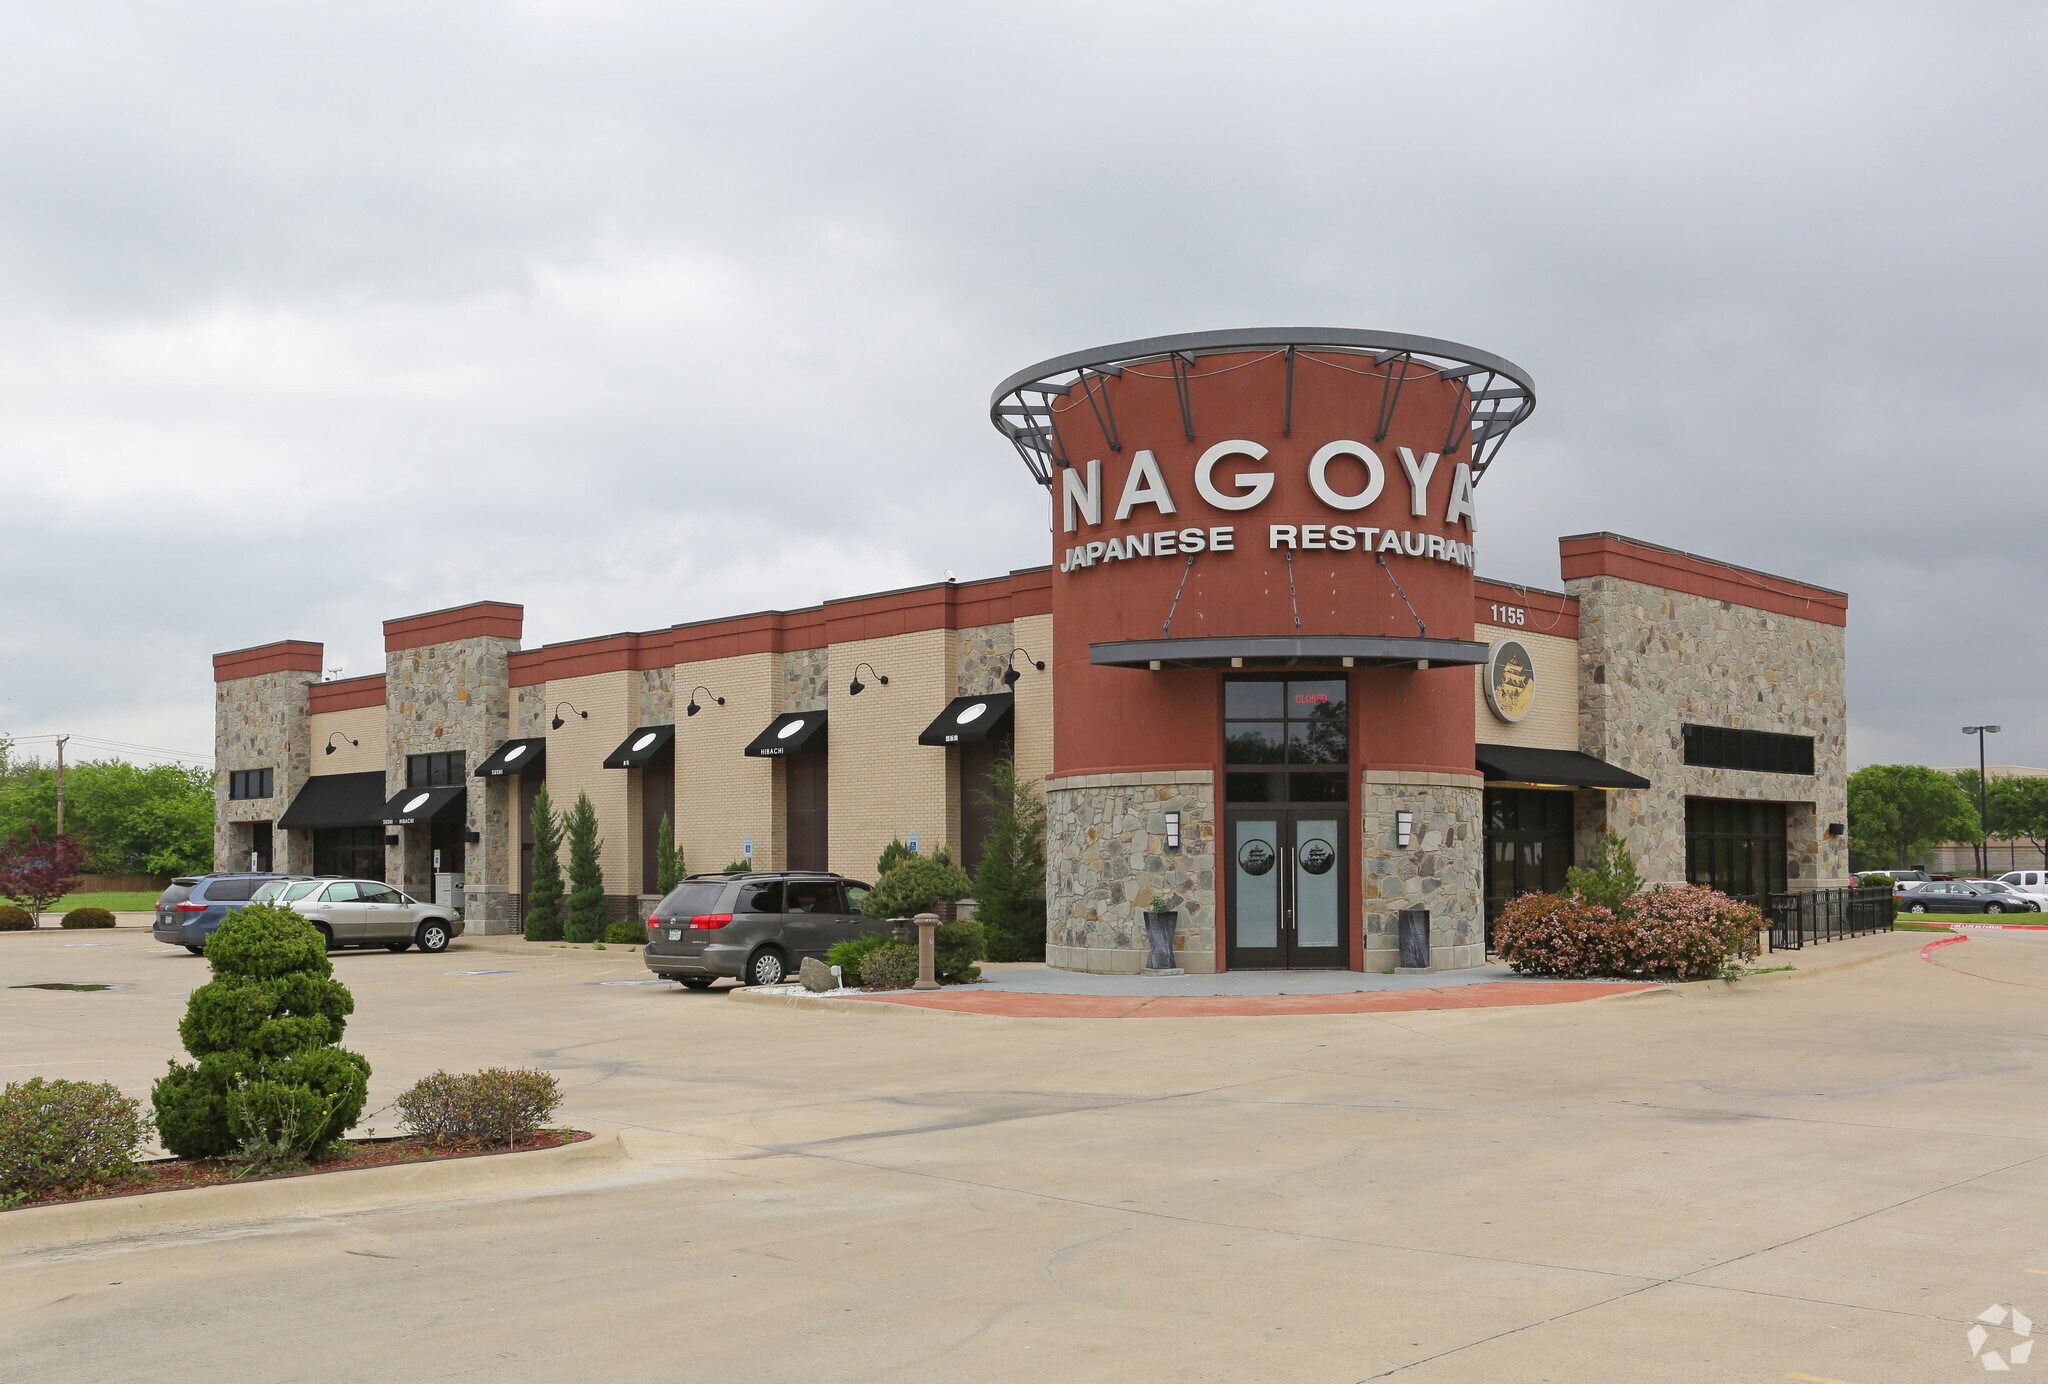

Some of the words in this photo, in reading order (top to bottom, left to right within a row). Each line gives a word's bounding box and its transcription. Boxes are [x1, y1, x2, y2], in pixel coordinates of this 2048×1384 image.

[1062, 439, 1477, 533] NAGOYA
[1060, 526, 1235, 573] JAPANESE
[1490, 604, 1525, 626] 1155
[1295, 694, 1328, 704] CLOSED
[760, 747, 784, 755] HIBACHI
